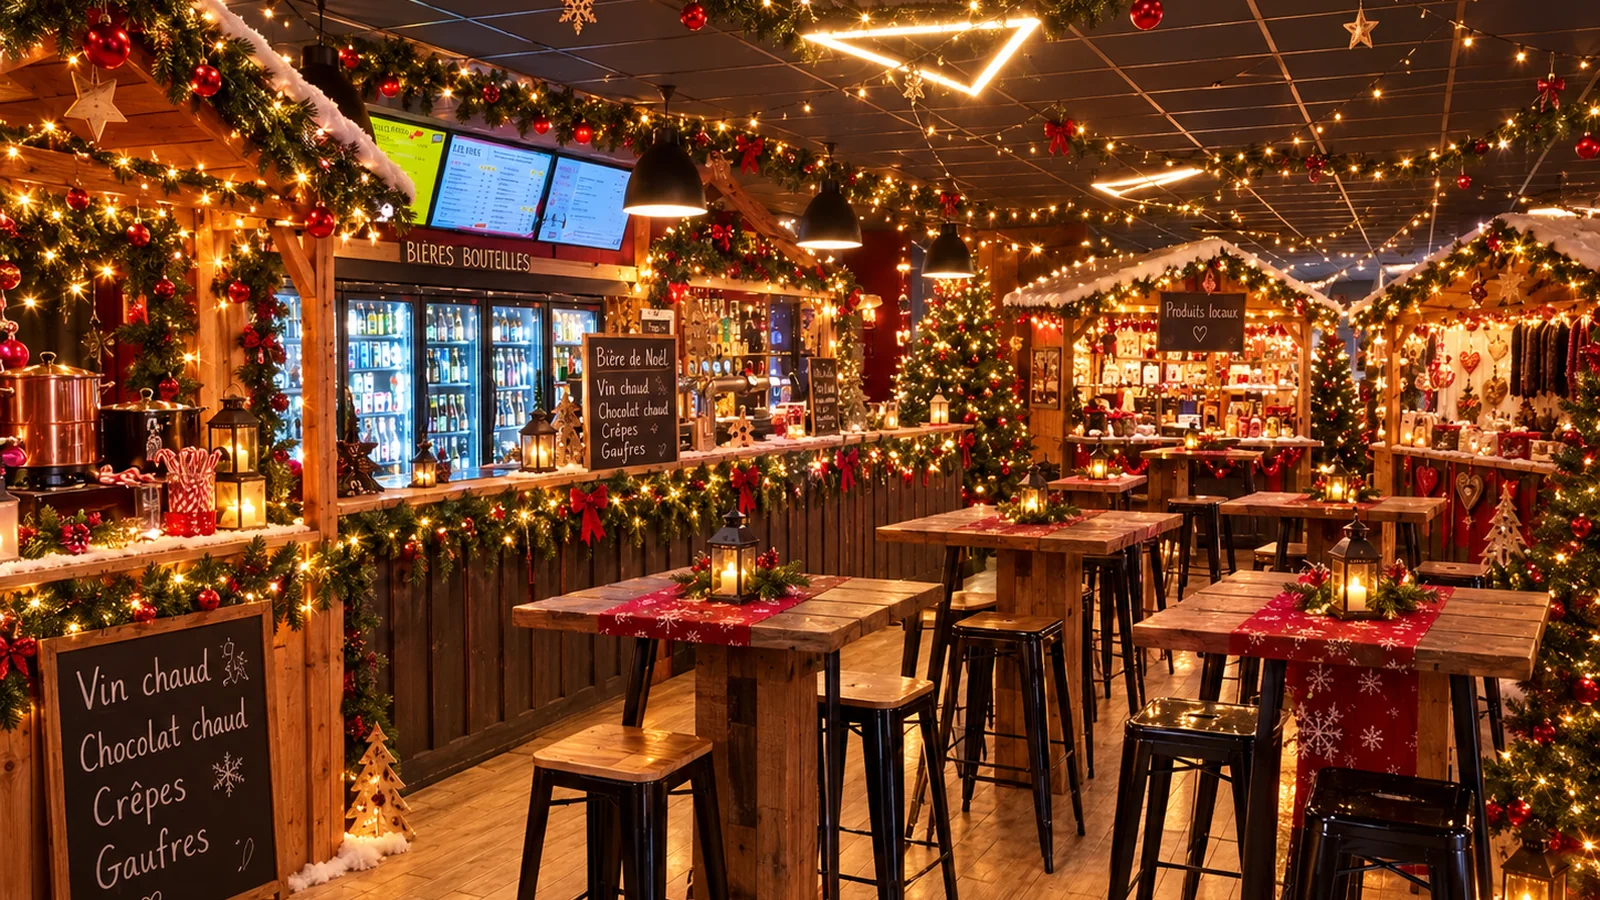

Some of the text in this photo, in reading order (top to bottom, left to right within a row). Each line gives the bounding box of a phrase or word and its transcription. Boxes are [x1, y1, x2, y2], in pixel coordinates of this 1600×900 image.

[406, 240, 531, 272] BIÈRES BOUTEILLES
[1166, 300, 1239, 319] Produits locaux
[596, 346, 625, 367] Bière
[629, 348, 641, 366] de
[596, 377, 650, 397] Vin chaud
[598, 400, 669, 420] Chocolat chaud
[601, 441, 646, 464] Gaufres
[76, 647, 212, 711] Vin chaud
[79, 696, 249, 773] Chocolat chaud
[93, 777, 187, 827] Crêpes
[95, 827, 210, 890] Gaufres
